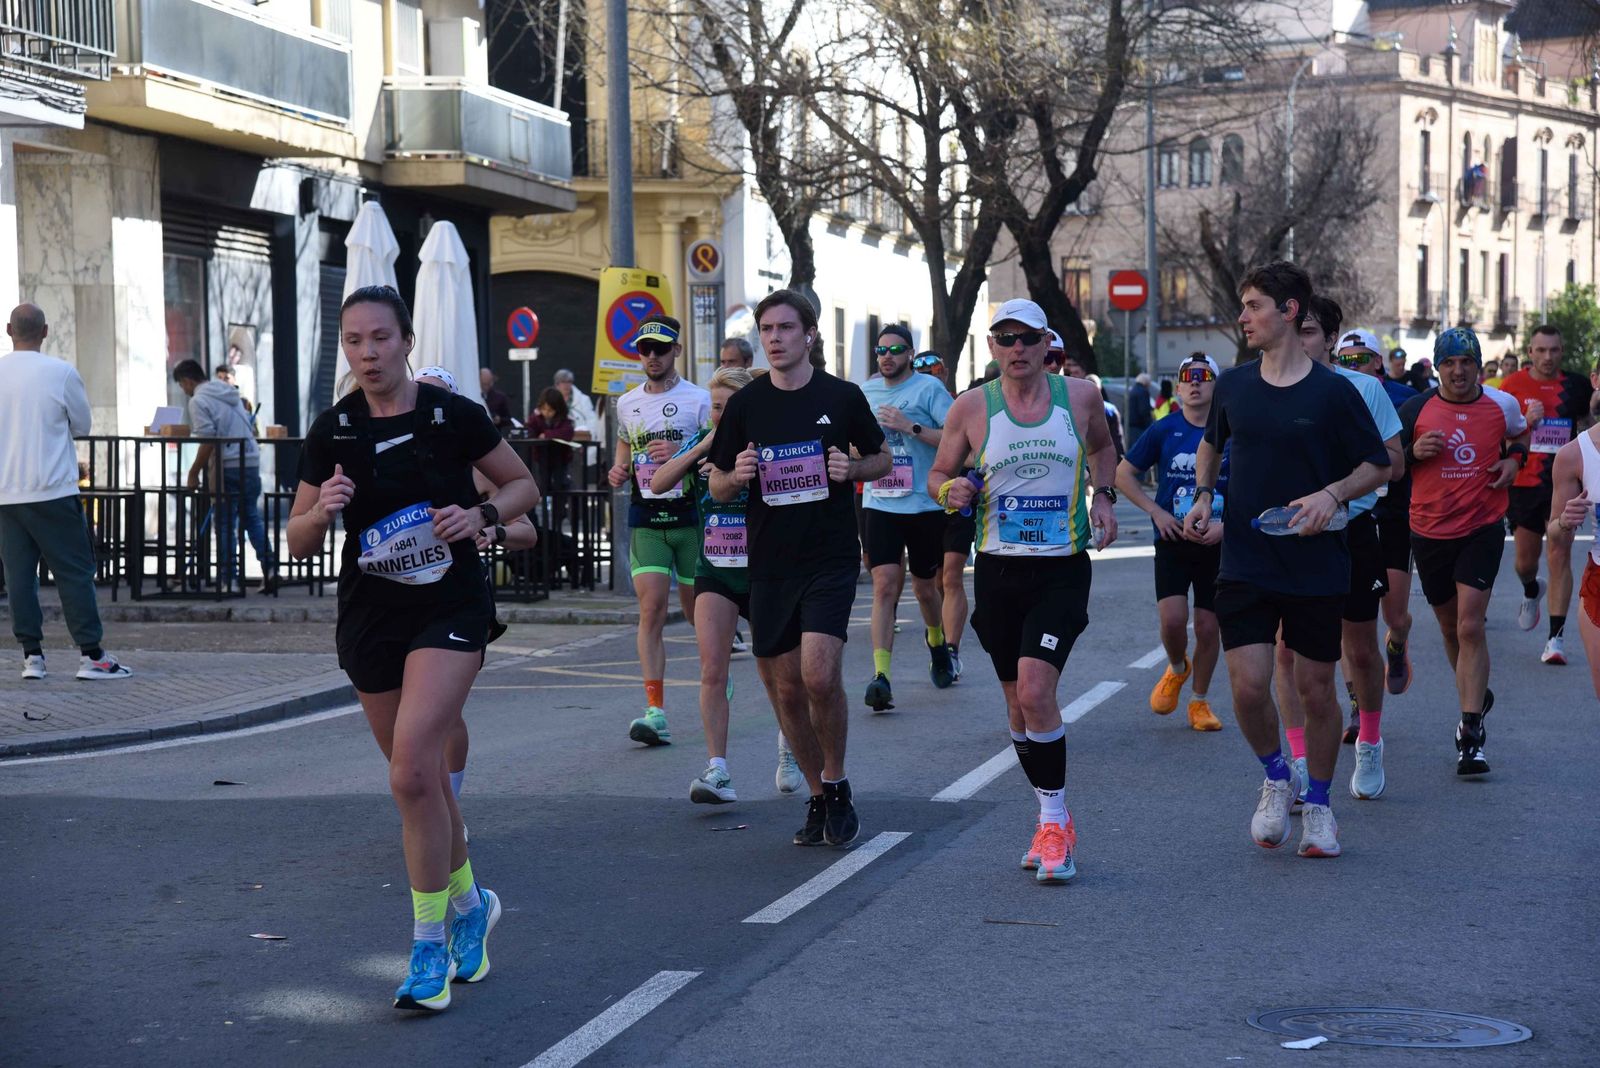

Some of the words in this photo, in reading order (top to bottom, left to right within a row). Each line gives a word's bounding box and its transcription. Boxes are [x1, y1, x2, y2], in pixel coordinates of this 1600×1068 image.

[778, 445, 815, 457] ZURICH
[1008, 439, 1056, 451] ROYTON
[990, 455, 1019, 474] ROAD
[1022, 452, 1073, 467] RUNNERS
[780, 464, 804, 475] 10400
[766, 474, 822, 493] KREUGER
[877, 478, 905, 488] URBÁN
[1022, 499, 1061, 508] ZURICH
[384, 507, 429, 535] ZURICH
[1023, 518, 1044, 527] 8677
[722, 533, 743, 541] 12082
[1019, 530, 1048, 543] NEIL
[705, 546, 728, 555] MOLY
[366, 545, 446, 573] ANNELIES
